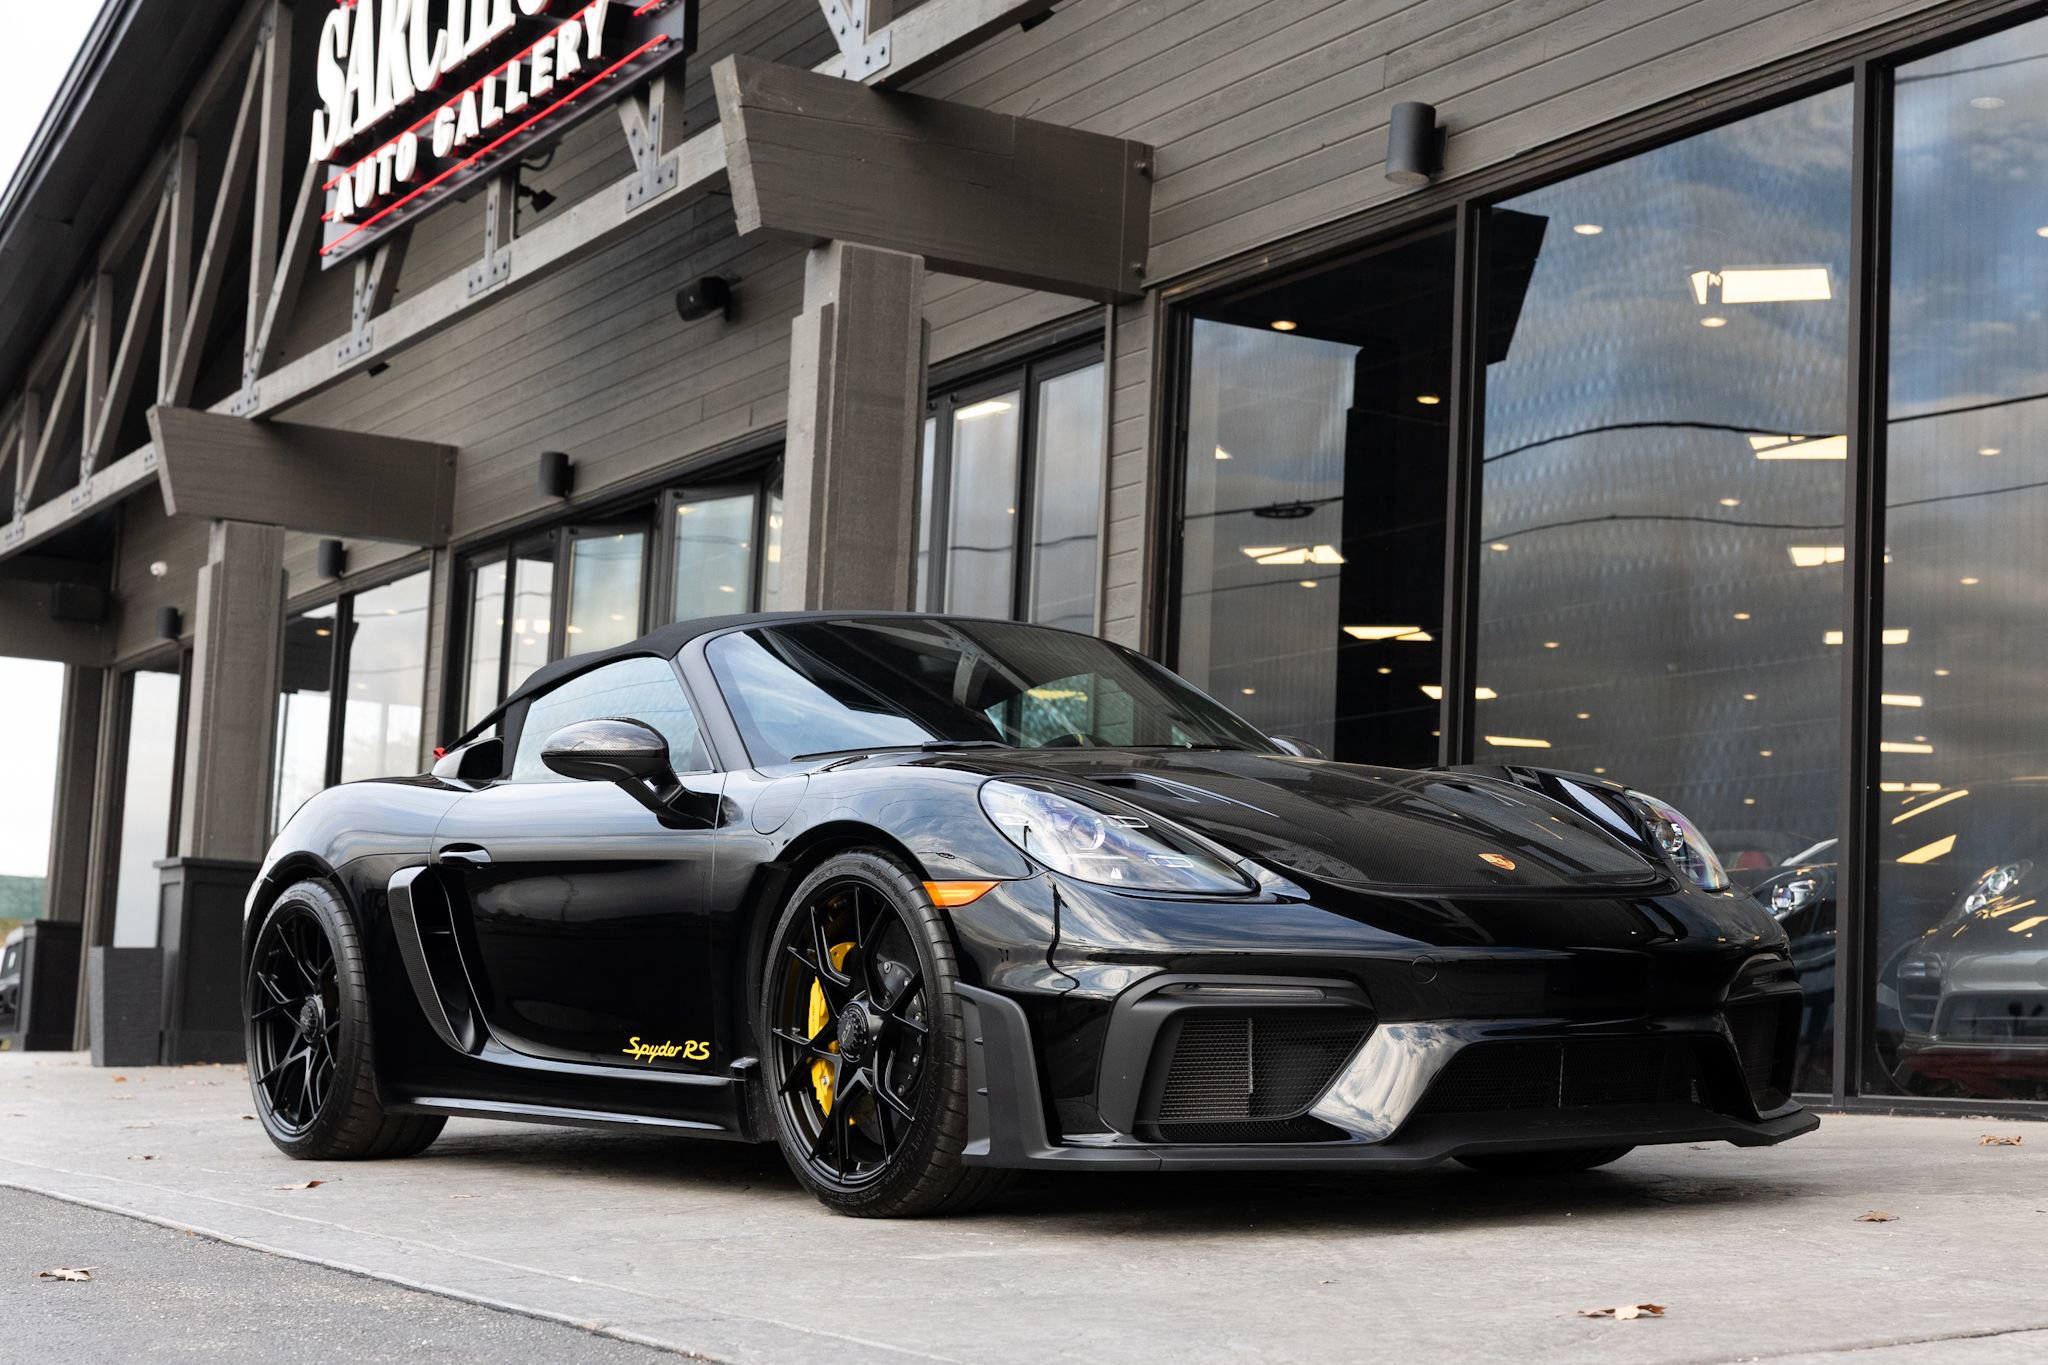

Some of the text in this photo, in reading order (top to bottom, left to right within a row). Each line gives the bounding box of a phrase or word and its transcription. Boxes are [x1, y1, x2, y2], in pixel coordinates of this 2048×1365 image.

[333, 0, 609, 223] AUTO GALLERY
[622, 1036, 710, 1064] Spyder RS
